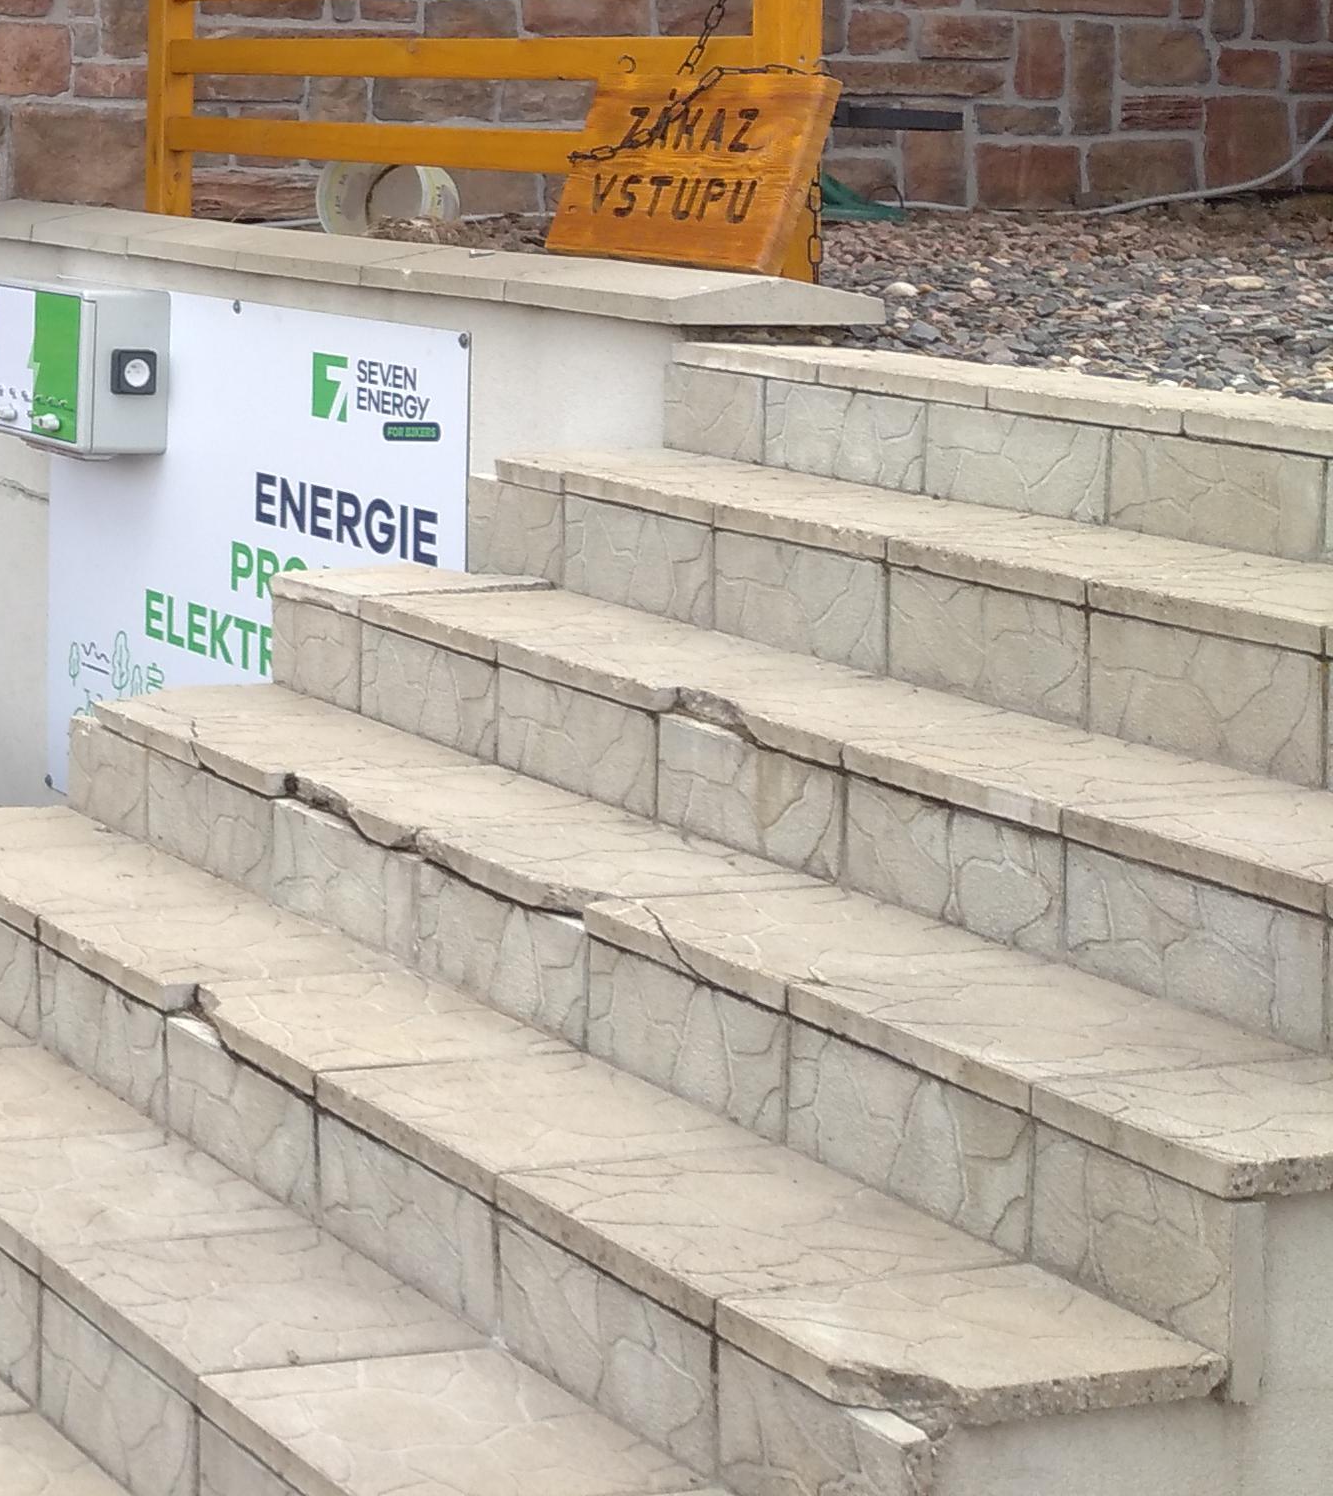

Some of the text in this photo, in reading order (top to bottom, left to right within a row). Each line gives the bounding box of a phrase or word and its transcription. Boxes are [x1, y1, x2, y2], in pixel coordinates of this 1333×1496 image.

[592, 173, 759, 224] VSTUPU
[356, 386, 431, 421] ENERGY
[387, 426, 404, 438] FOR
[255, 471, 438, 567] ENERGIE
